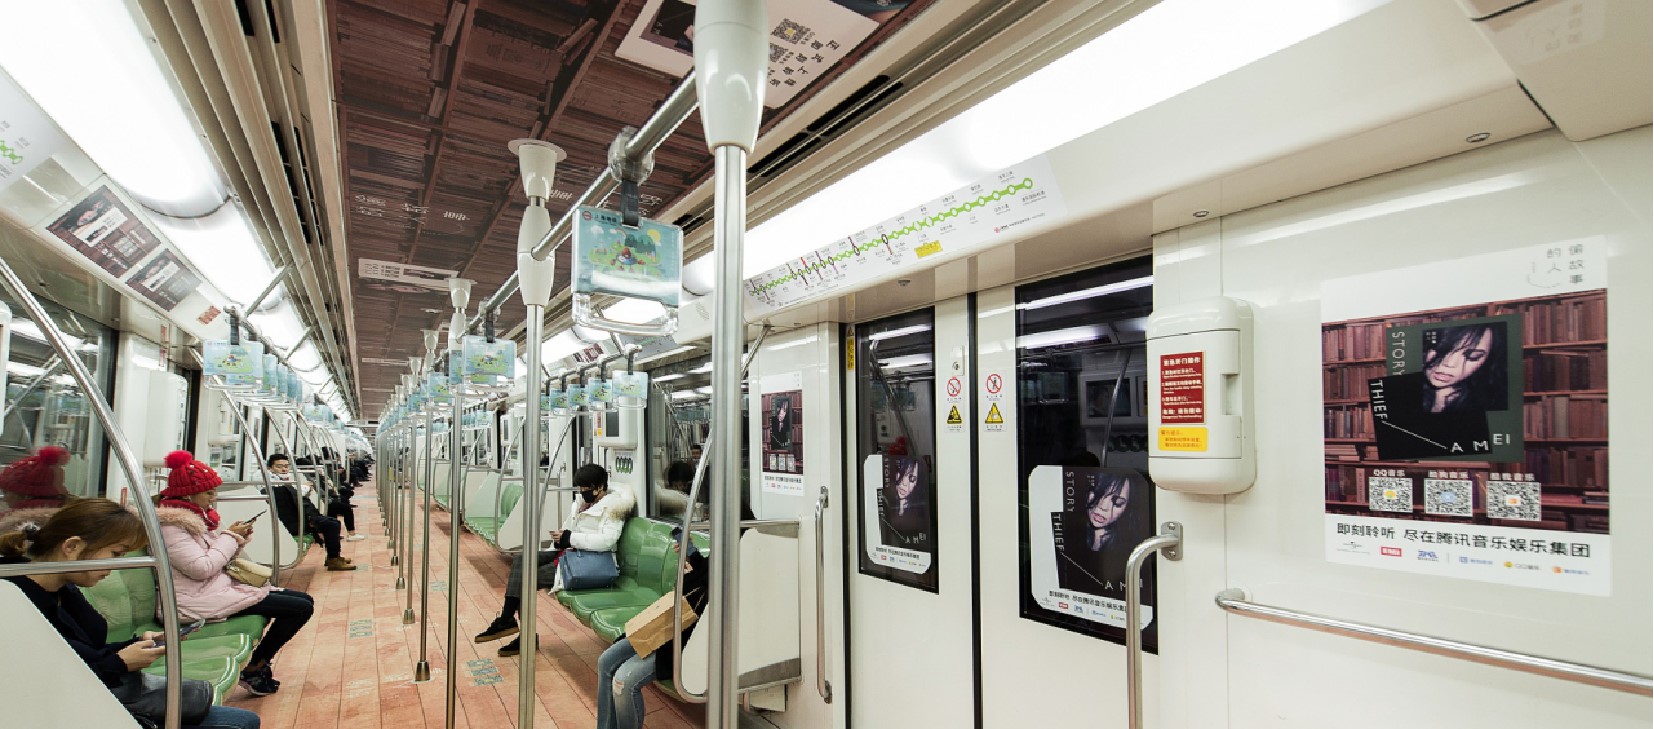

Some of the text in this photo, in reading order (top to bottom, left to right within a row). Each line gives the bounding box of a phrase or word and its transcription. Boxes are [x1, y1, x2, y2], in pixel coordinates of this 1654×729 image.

[1391, 331, 1406, 376] STORY
[1369, 379, 1389, 420] THIEF
[1451, 442, 1464, 453] A
[1066, 471, 1075, 513] STORY
[1053, 513, 1064, 551] THIEF
[1337, 522, 1396, 540] 即刻聆听
[1404, 529, 1591, 558] 尽在腾讯音乐娱乐集团
